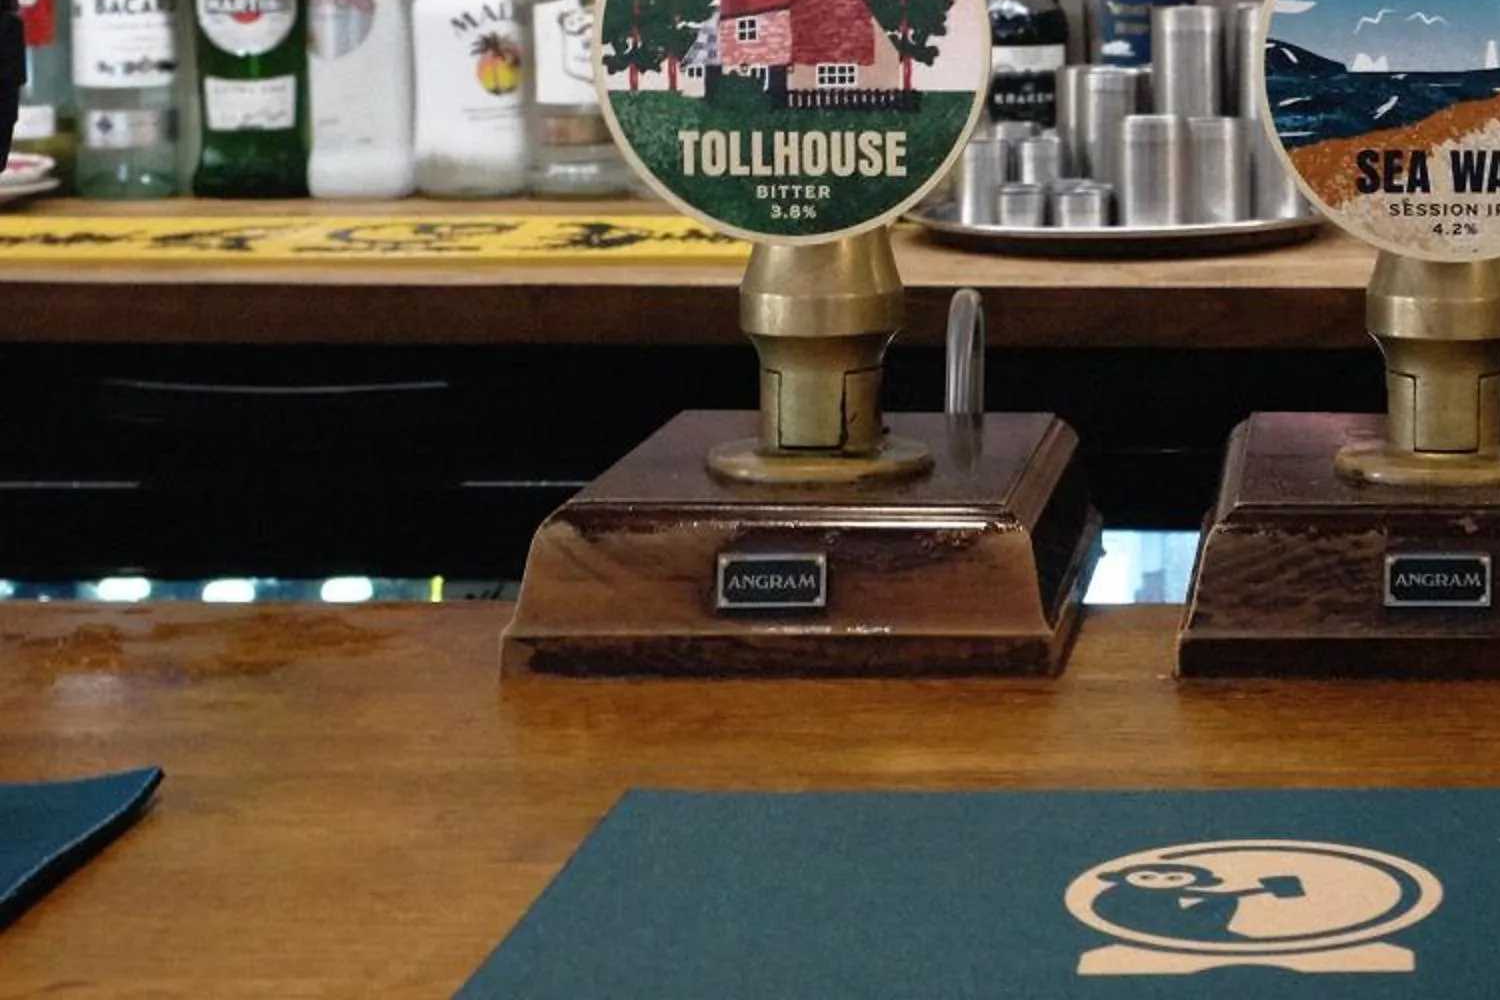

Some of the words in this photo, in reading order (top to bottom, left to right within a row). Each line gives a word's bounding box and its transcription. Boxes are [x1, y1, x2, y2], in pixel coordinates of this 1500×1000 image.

[678, 131, 907, 177] TOLLHOUSE
[1356, 150, 1430, 194] SEA
[756, 185, 831, 200] BITTER
[770, 204, 817, 219] 3.8%
[1388, 204, 1479, 217] SESSION
[1432, 223, 1479, 236] 4.2%
[728, 574, 816, 589] ANGRAM
[1395, 573, 1482, 587] ANGRAM
